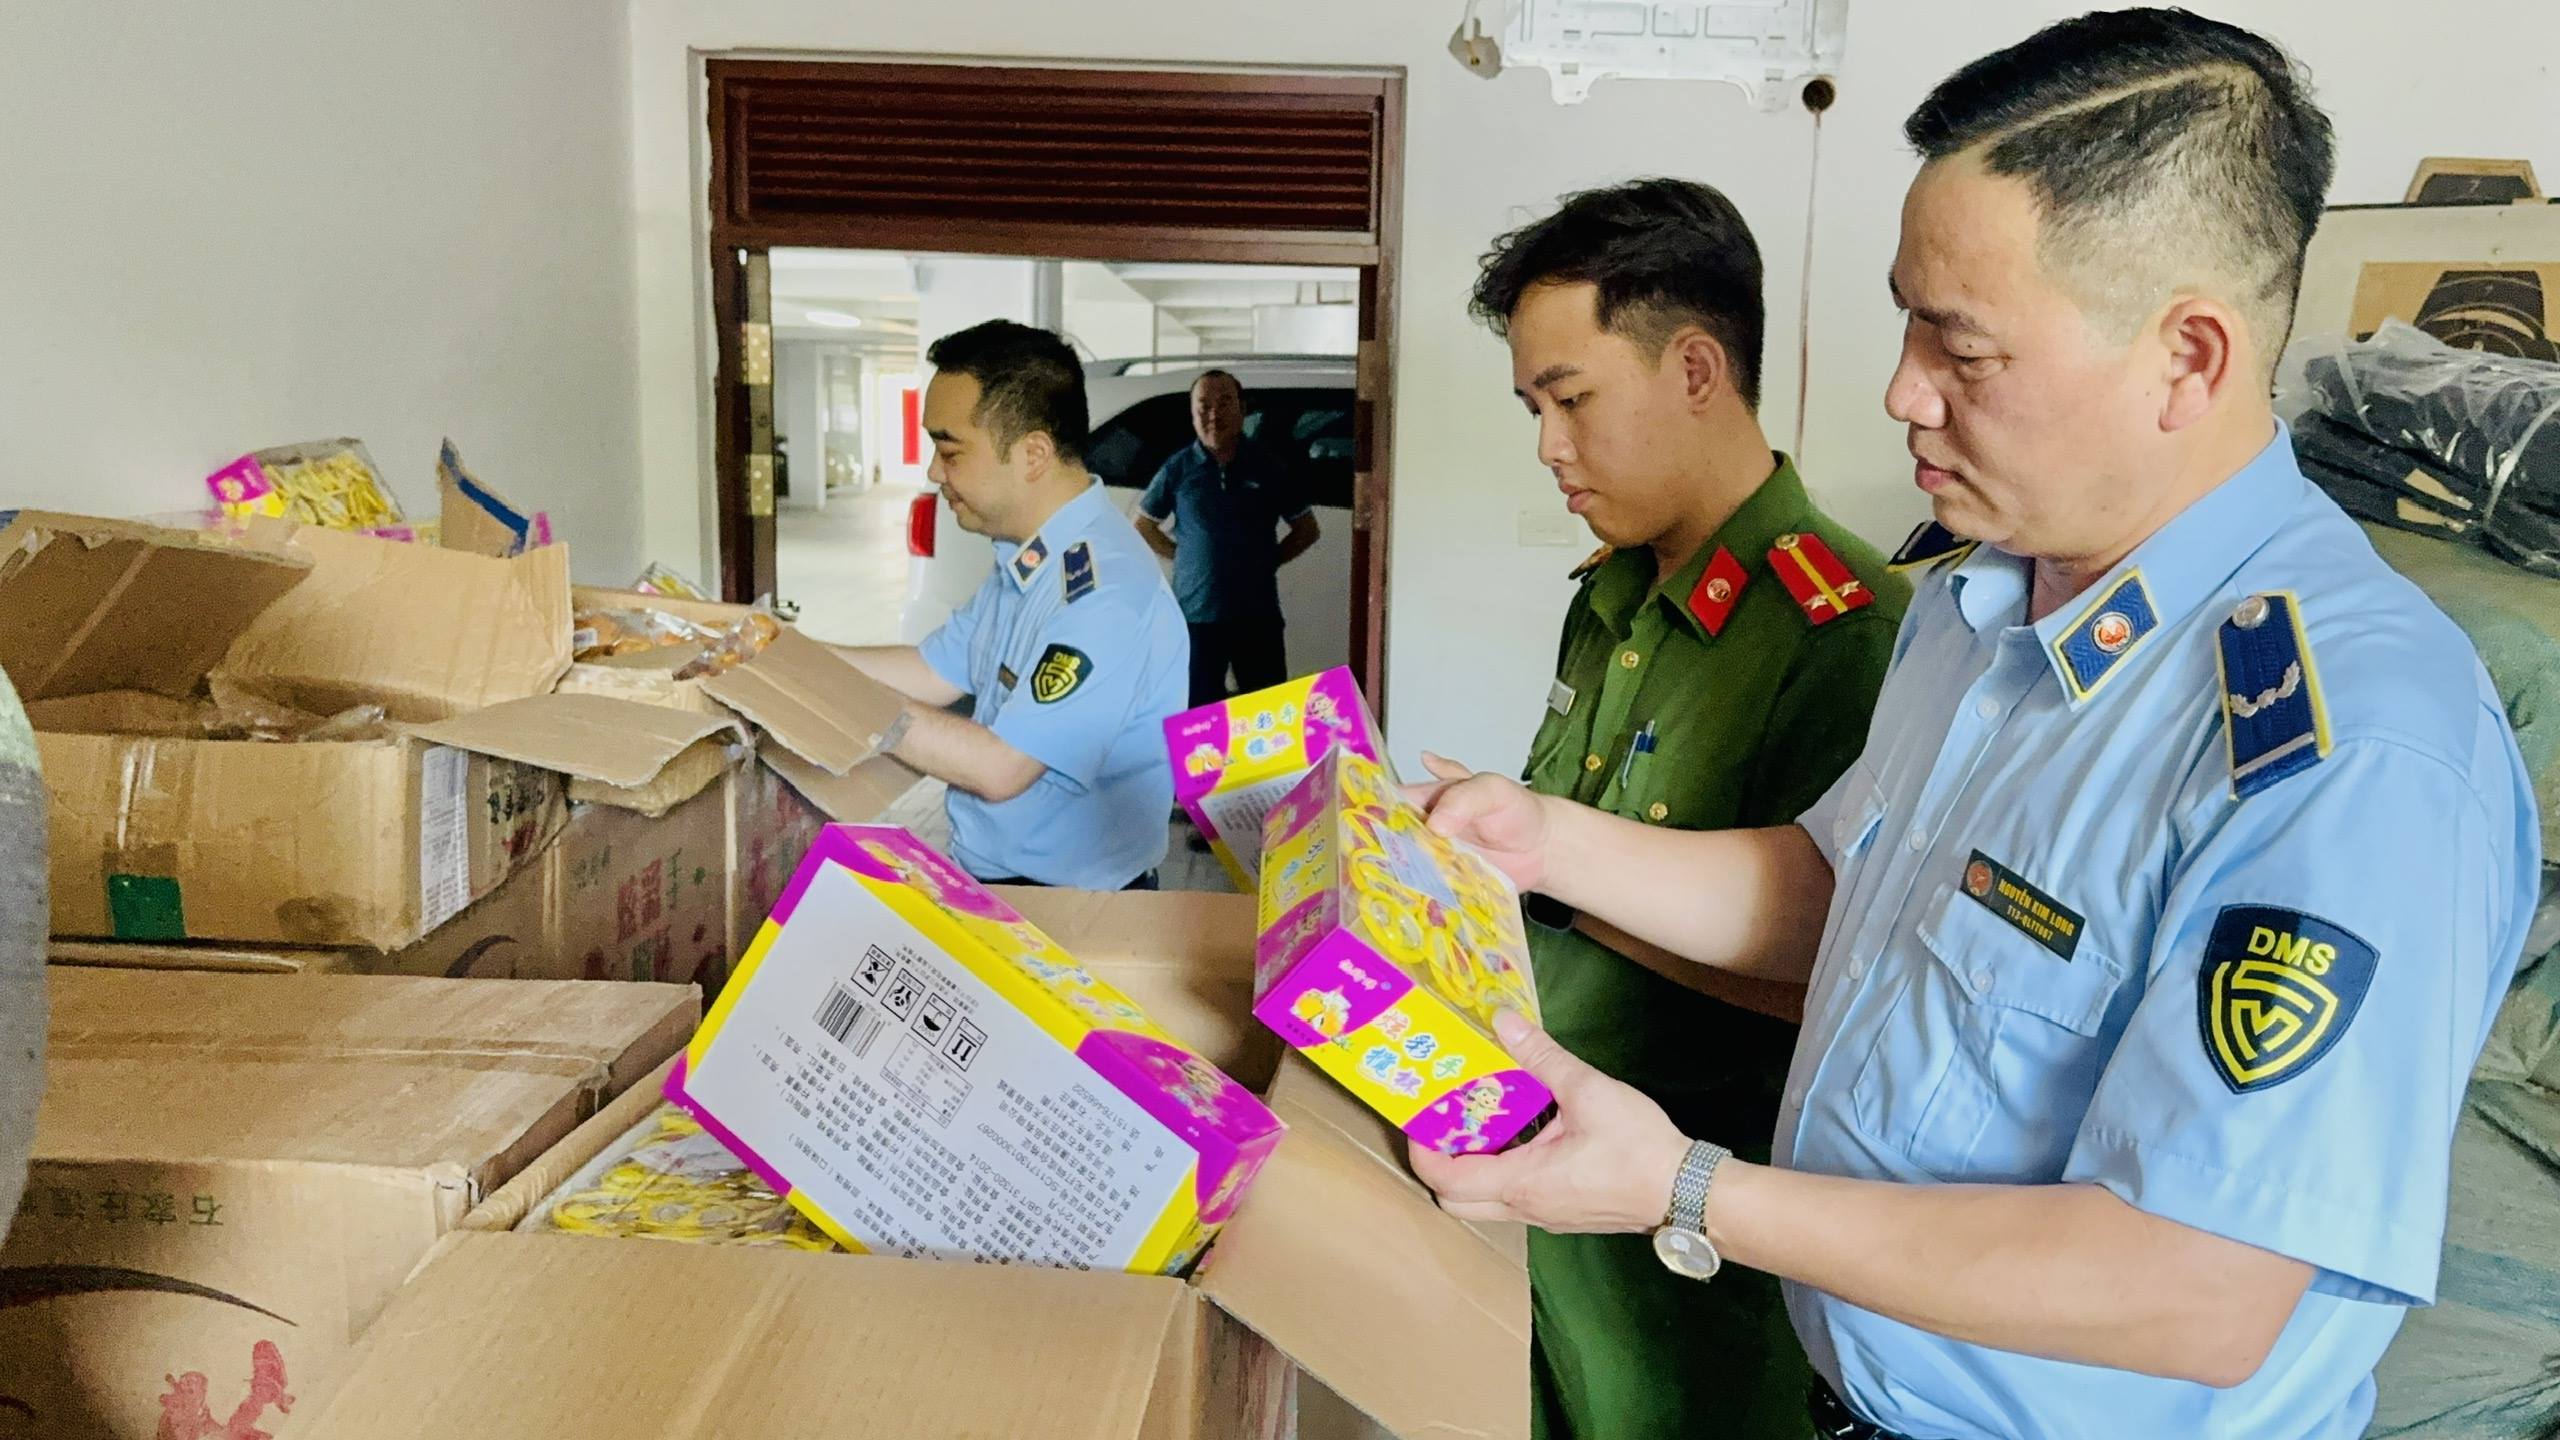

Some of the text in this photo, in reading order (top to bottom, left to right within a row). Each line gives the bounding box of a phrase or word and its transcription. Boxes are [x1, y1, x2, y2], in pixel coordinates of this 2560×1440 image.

[2031, 901, 2051, 921] KIM
[2049, 911, 2076, 937] LONG
[2247, 926, 2336, 976] DMS
[967, 1151, 1099, 1263] 产品标准代号 GB/T 31320-2014
[1046, 1196, 1107, 1250] 保质期 12个月
[1057, 1186, 1116, 1237] 生产许可证号
[1083, 1188, 1123, 1224] 生产日期
